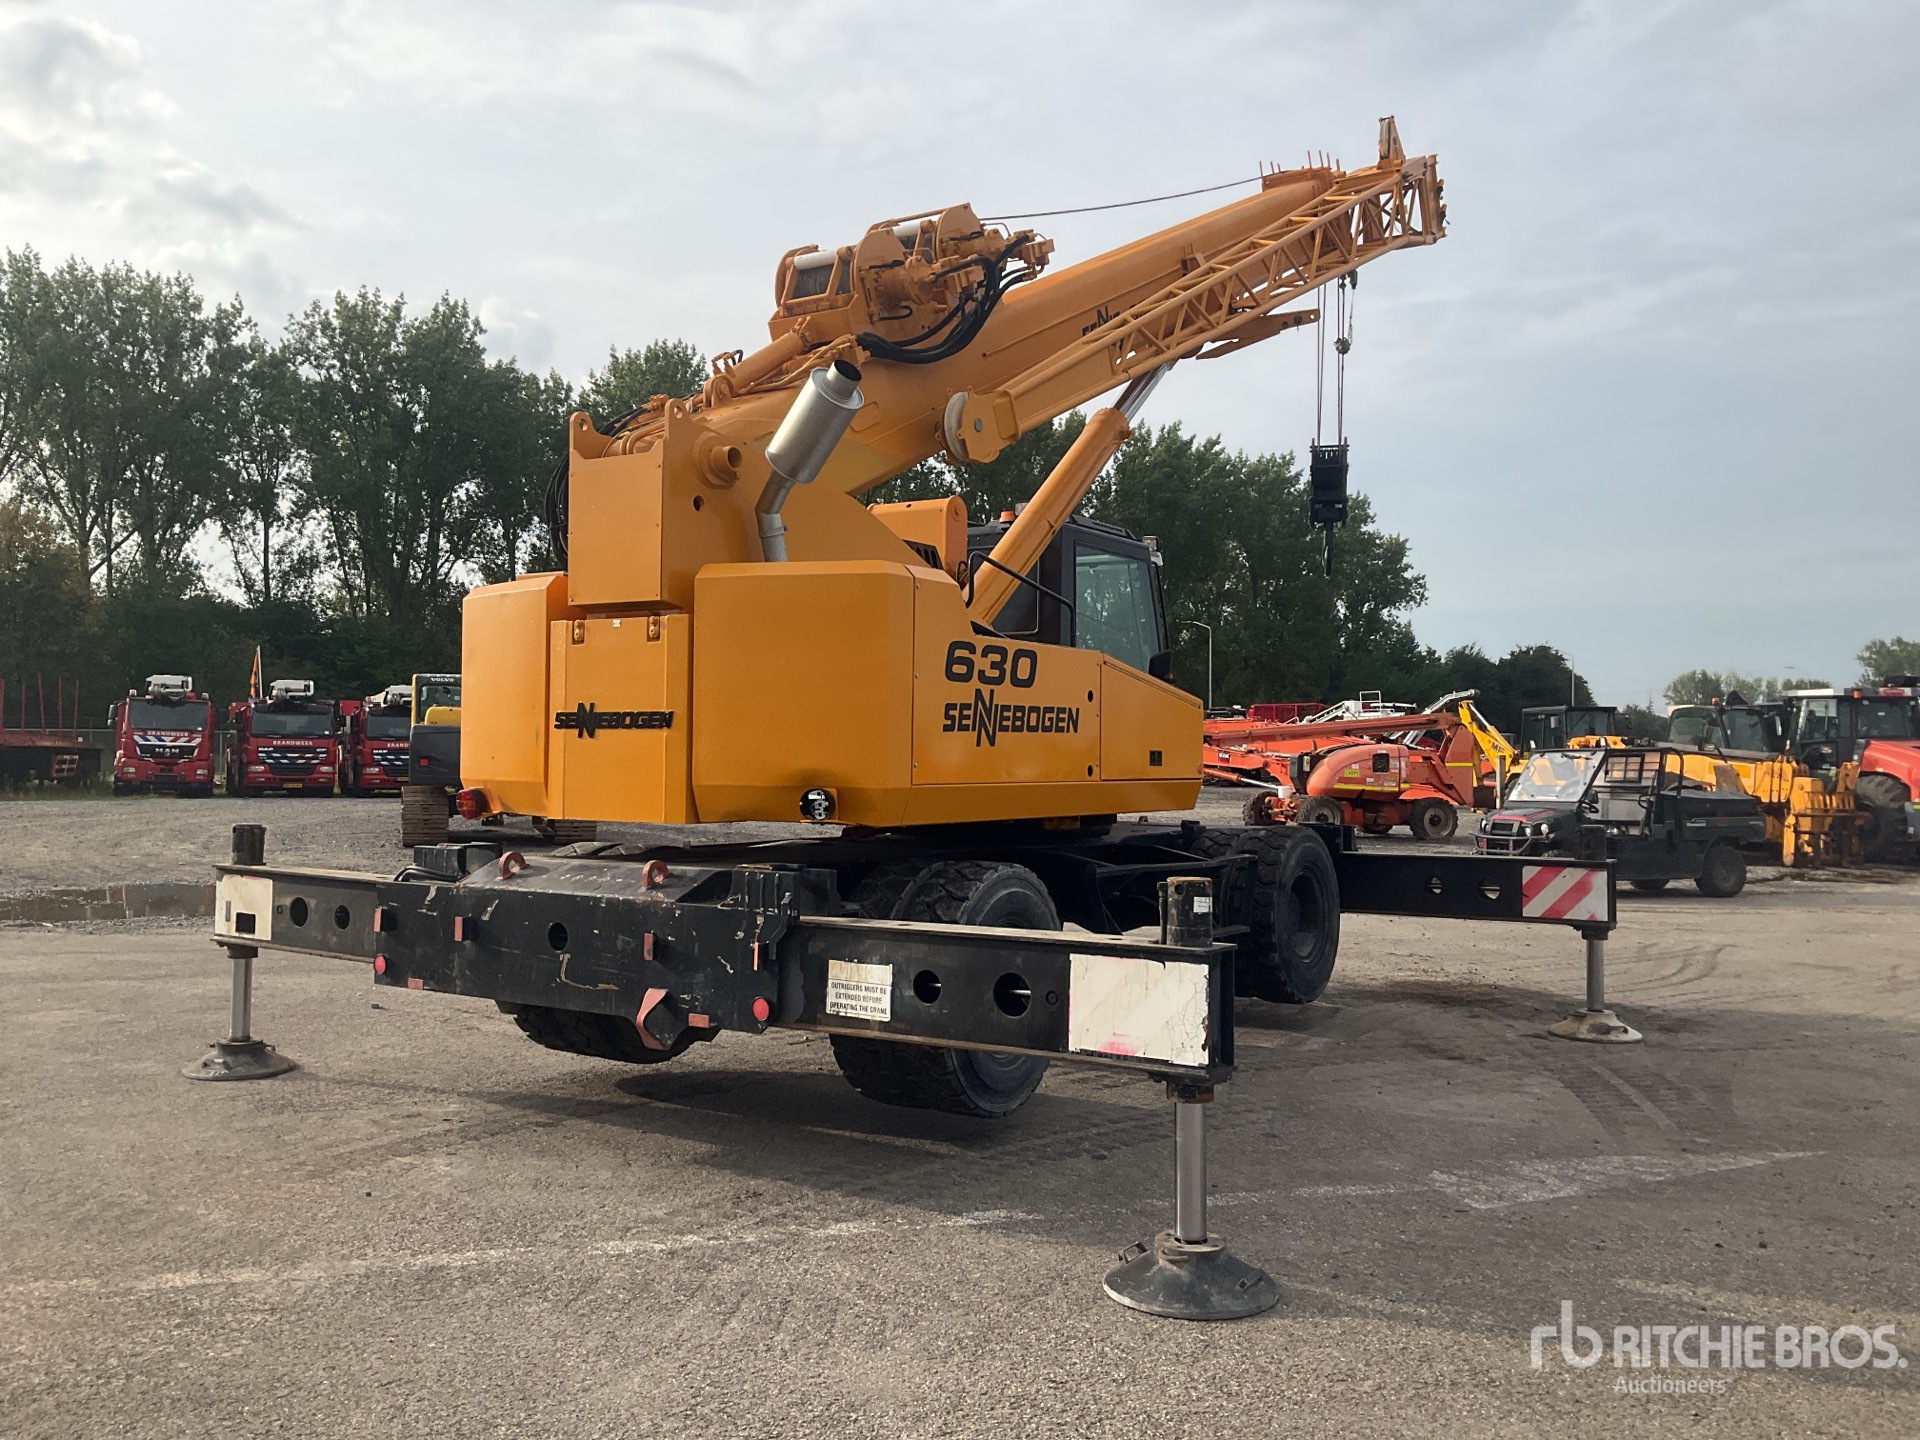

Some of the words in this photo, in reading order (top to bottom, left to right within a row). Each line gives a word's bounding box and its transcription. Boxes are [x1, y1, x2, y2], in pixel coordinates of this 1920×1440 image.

[944, 640, 1037, 688] 630
[554, 702, 674, 738] SENNEBOGEN
[942, 688, 1080, 747] SENNEBOGEN
[831, 982, 863, 992] OUTRIGGERS
[864, 985, 879, 994] MUST
[879, 987, 887, 995] BE
[835, 992, 861, 1002] EXTENDED
[862, 995, 882, 1005] BEFORE
[830, 1002, 858, 1011] OPERATING
[859, 1005, 869, 1013] THE
[870, 1006, 888, 1015] CRANE
